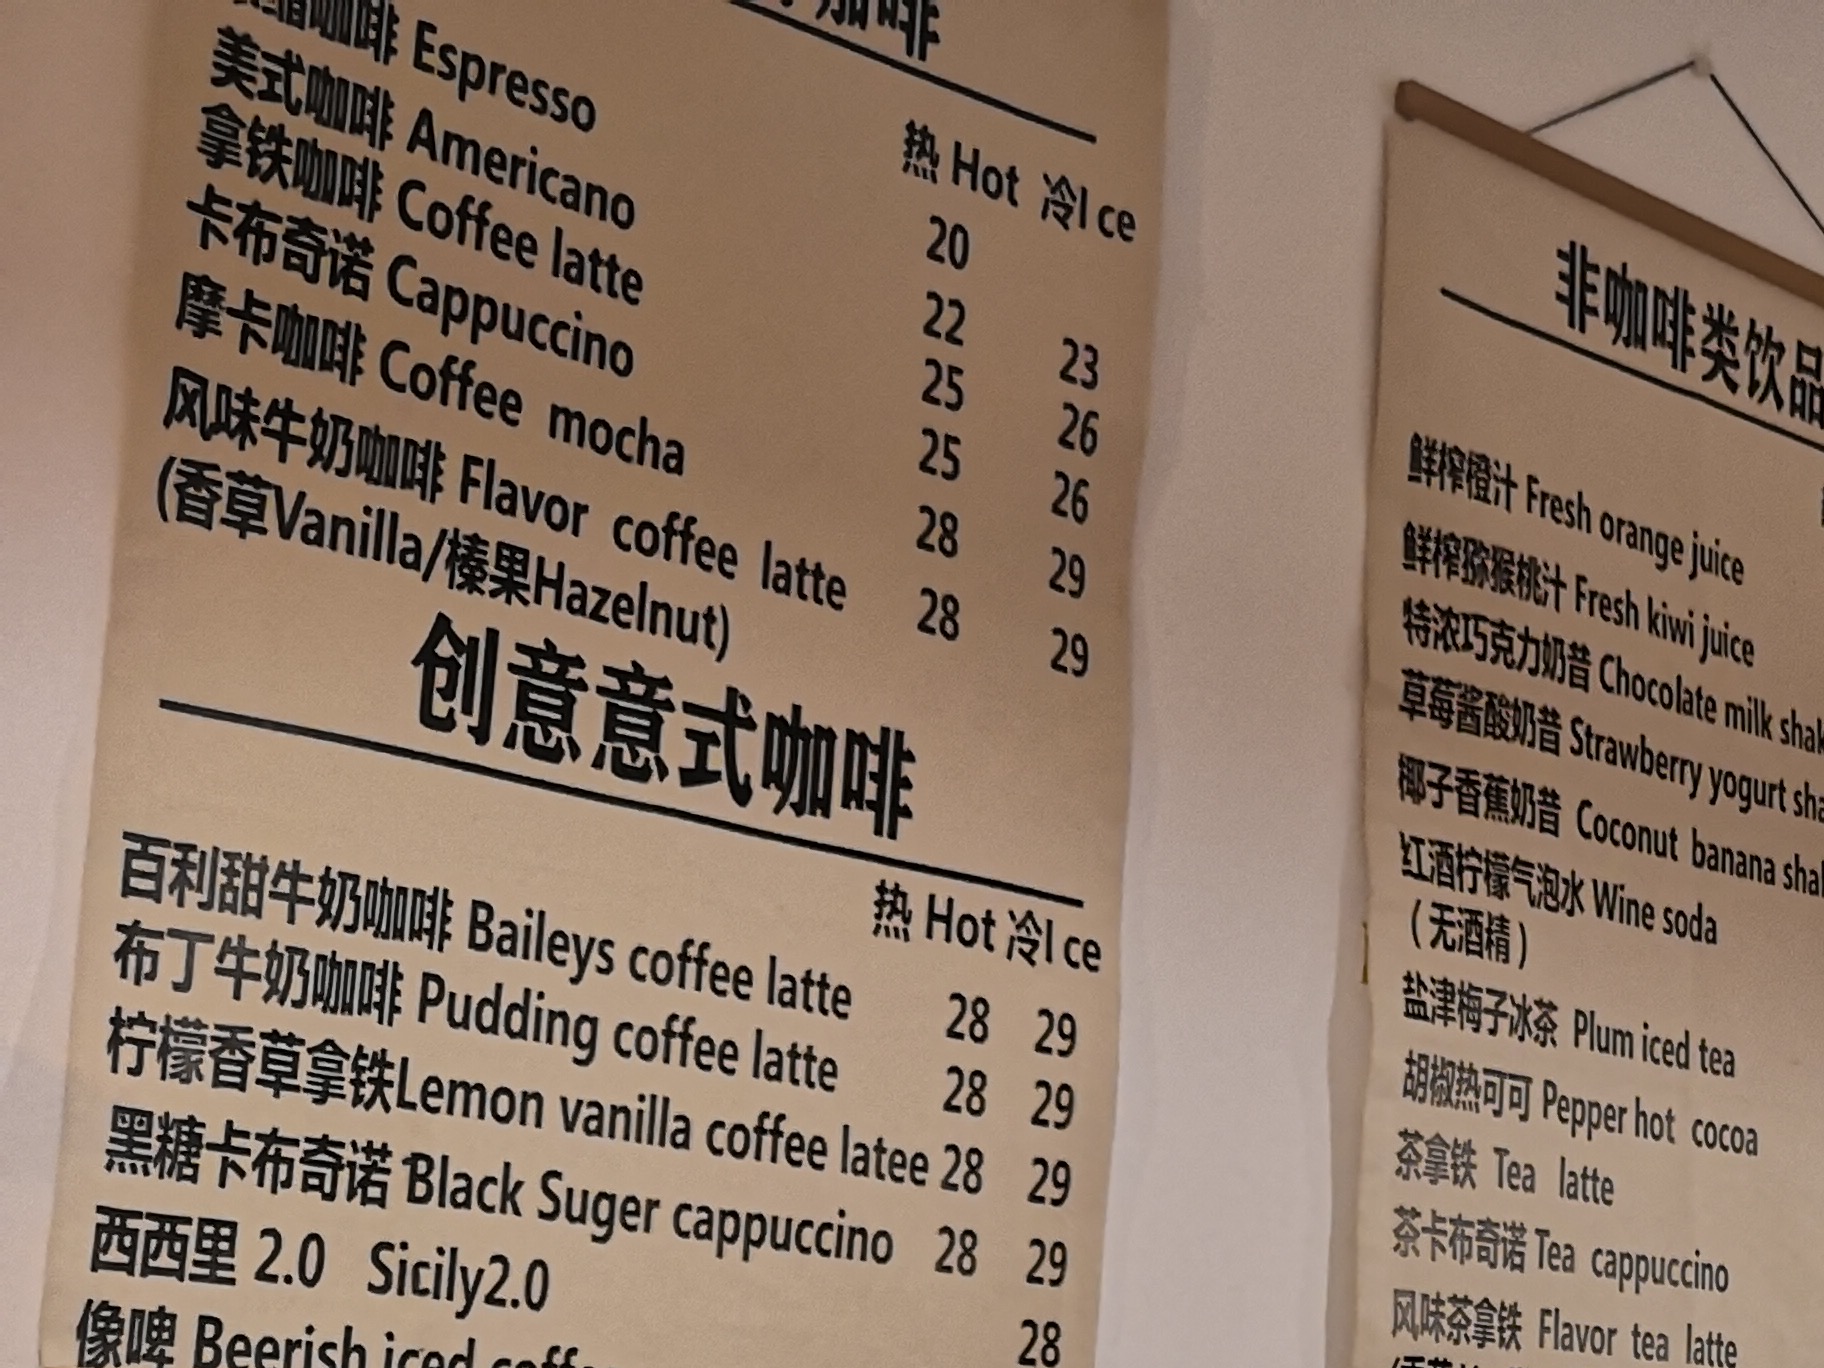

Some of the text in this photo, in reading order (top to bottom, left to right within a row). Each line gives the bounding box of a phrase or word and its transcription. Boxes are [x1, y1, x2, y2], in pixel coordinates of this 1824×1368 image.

[413, 20, 596, 133] Espresso
[210, 25, 635, 230] 美式咖啡 Americano
[952, 141, 1019, 208] Hot
[196, 103, 643, 306] 拿铁咖啡 Coffee latte
[926, 215, 969, 270] 20
[186, 183, 633, 377] 卡布奇诺 Cappuccino
[175, 271, 684, 476] 摩卡咖啡 Coffee mocha
[923, 291, 1098, 390] 22 23
[922, 358, 1099, 457] 25 26
[460, 454, 589, 537] Flavor
[613, 511, 738, 580] coffee
[762, 540, 846, 611] latte
[916, 505, 1085, 599] 28 29
[1527, 474, 1592, 534] Fresh
[1600, 511, 1684, 572] orange
[1688, 530, 1744, 585] juice
[1575, 574, 1639, 631] Fresh
[1648, 595, 1694, 649] kiwi
[1699, 613, 1754, 667] juice
[411, 611, 916, 841] 创意意式咖啡
[1599, 654, 1717, 725] Chocolate
[1725, 695, 1773, 741] milk
[1570, 715, 1702, 800] Strawberry
[1709, 766, 1786, 814] yogurt
[1398, 753, 1561, 837] 椰子香蕉奶昔
[1577, 799, 1678, 862] Coconut
[1692, 827, 1775, 885] banana
[121, 831, 851, 1020] 百利甜牛奶咖啡 Baileys coffee latte
[926, 893, 996, 953] Hot
[1399, 831, 1717, 945] 红酒柠檬气泡水 Wine soda
[113, 919, 838, 1092] 布丁牛奶咖啡 Pudding coffee latte
[946, 992, 1077, 1058] 28 29
[1574, 1009, 1633, 1059] Plum
[1642, 1022, 1689, 1070] iced
[1699, 1038, 1735, 1077] tea
[560, 1094, 929, 1186] vanilla coffee latee
[1403, 1050, 1757, 1156] 胡椒热可可 Pepper hot cocoa
[104, 1105, 1067, 1287] 黑糖卡布奇诺 Black Suger cappuccino 28 29
[1395, 1128, 1614, 1206] 茶拿铁 Tea latte
[90, 1205, 238, 1286] 西西里
[254, 1228, 325, 1288] 2.0
[1393, 1205, 1728, 1294] 茶卡布奇诺 Tea cappuccino
[1018, 1319, 1061, 1368] 28
[1392, 1289, 1737, 1368] 风味茶拿铁 Flavor tea latte
